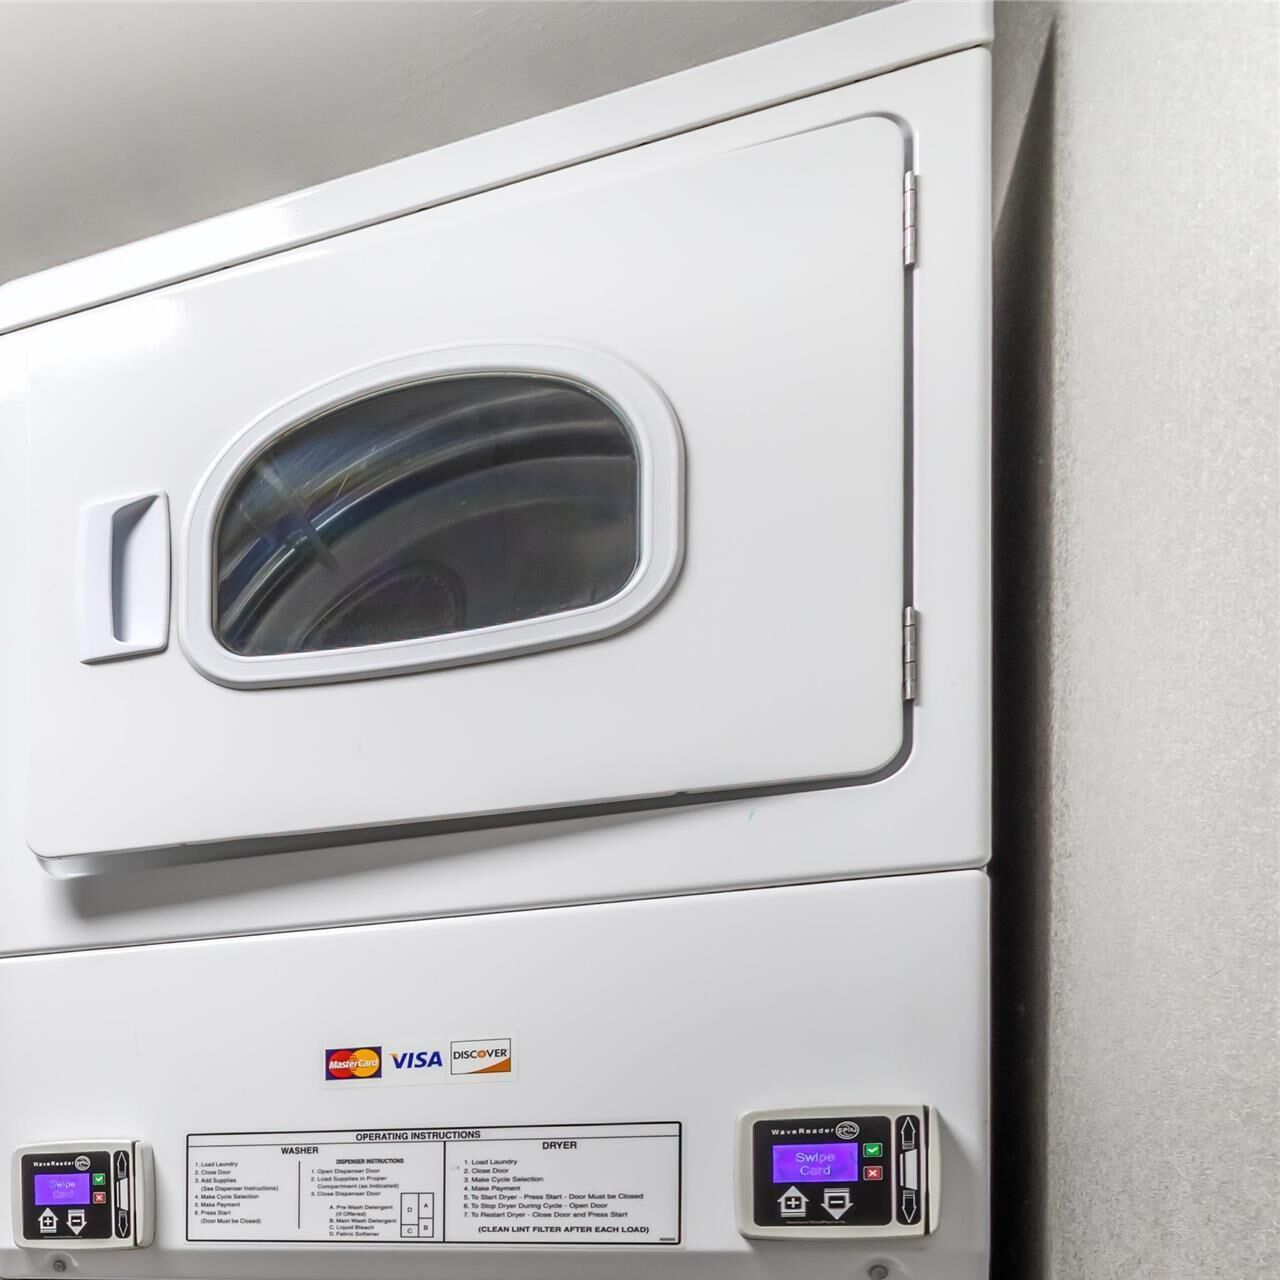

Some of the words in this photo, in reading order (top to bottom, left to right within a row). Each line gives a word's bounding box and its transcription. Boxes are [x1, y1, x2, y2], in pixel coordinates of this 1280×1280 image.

[453, 1049, 507, 1060] DISCOVER
[328, 1059, 378, 1069] MasterCard
[390, 1051, 443, 1069] VISA
[356, 1132, 408, 1141] OPERATING
[411, 1131, 481, 1140] INSTRUCTIONS
[772, 1128, 834, 1136] WaveReader
[542, 1141, 577, 1150] DRYER
[281, 1147, 319, 1155] WASHER
[796, 1152, 835, 1163] Swipe
[800, 1165, 831, 1176] Card
[621, 1226, 649, 1234] LOAD)
